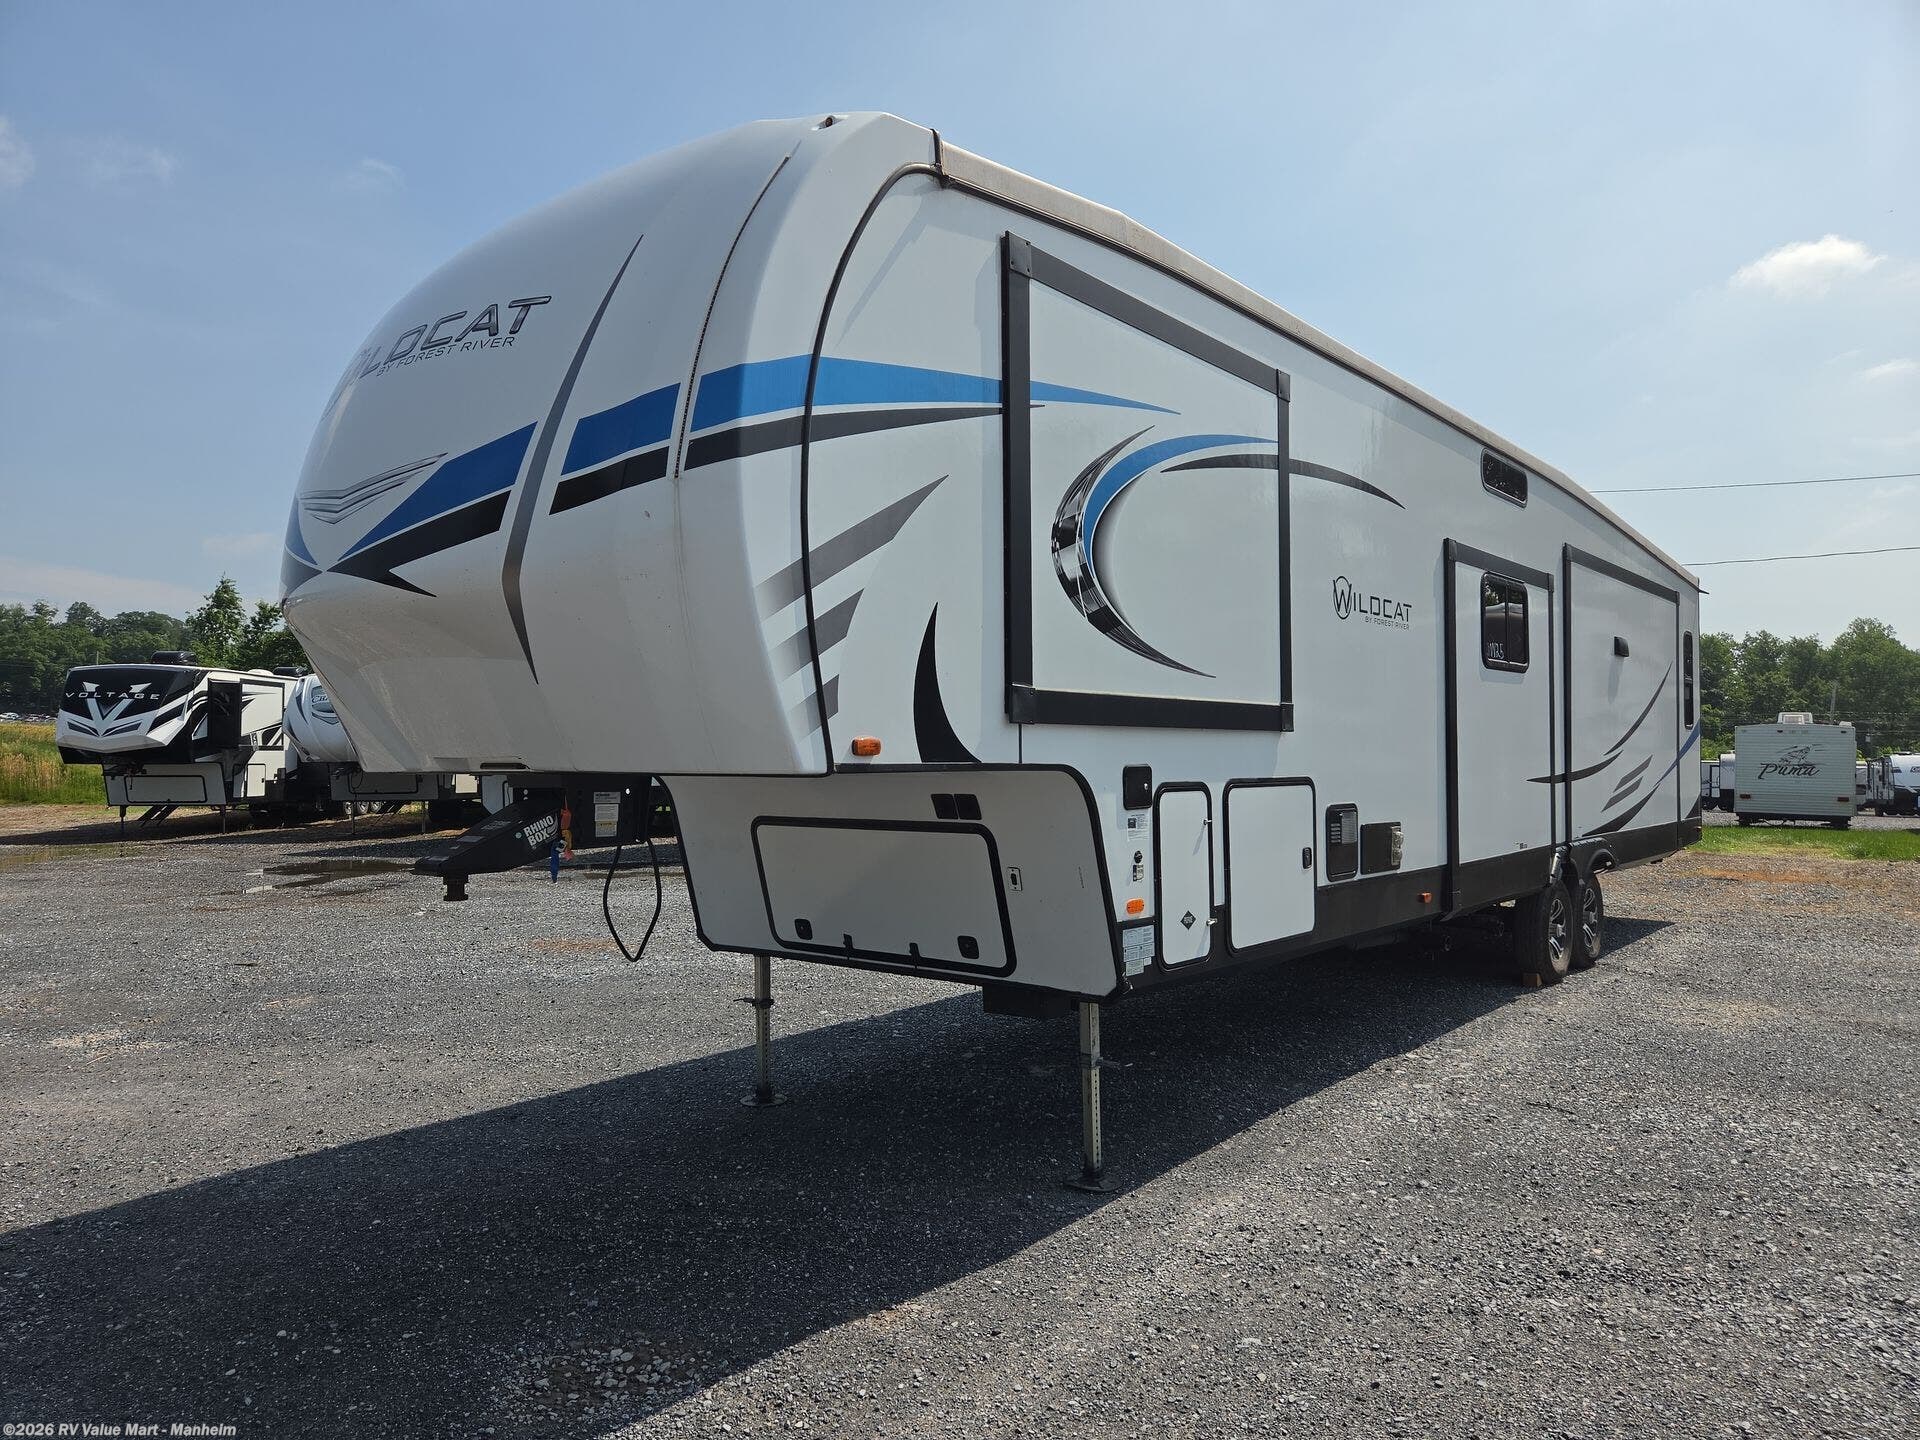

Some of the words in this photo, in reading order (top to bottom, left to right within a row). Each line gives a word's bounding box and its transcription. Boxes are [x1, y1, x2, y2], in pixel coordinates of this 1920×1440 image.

[375, 361, 394, 377] BY
[396, 344, 457, 369] FOREST
[460, 336, 516, 352] RIVER
[1332, 576, 1413, 622] WILDCAT
[65, 691, 160, 700] VOLTAGE
[1758, 762, 1820, 780] Puma
[523, 815, 554, 837] RHINO
[527, 828, 550, 847] BOX
